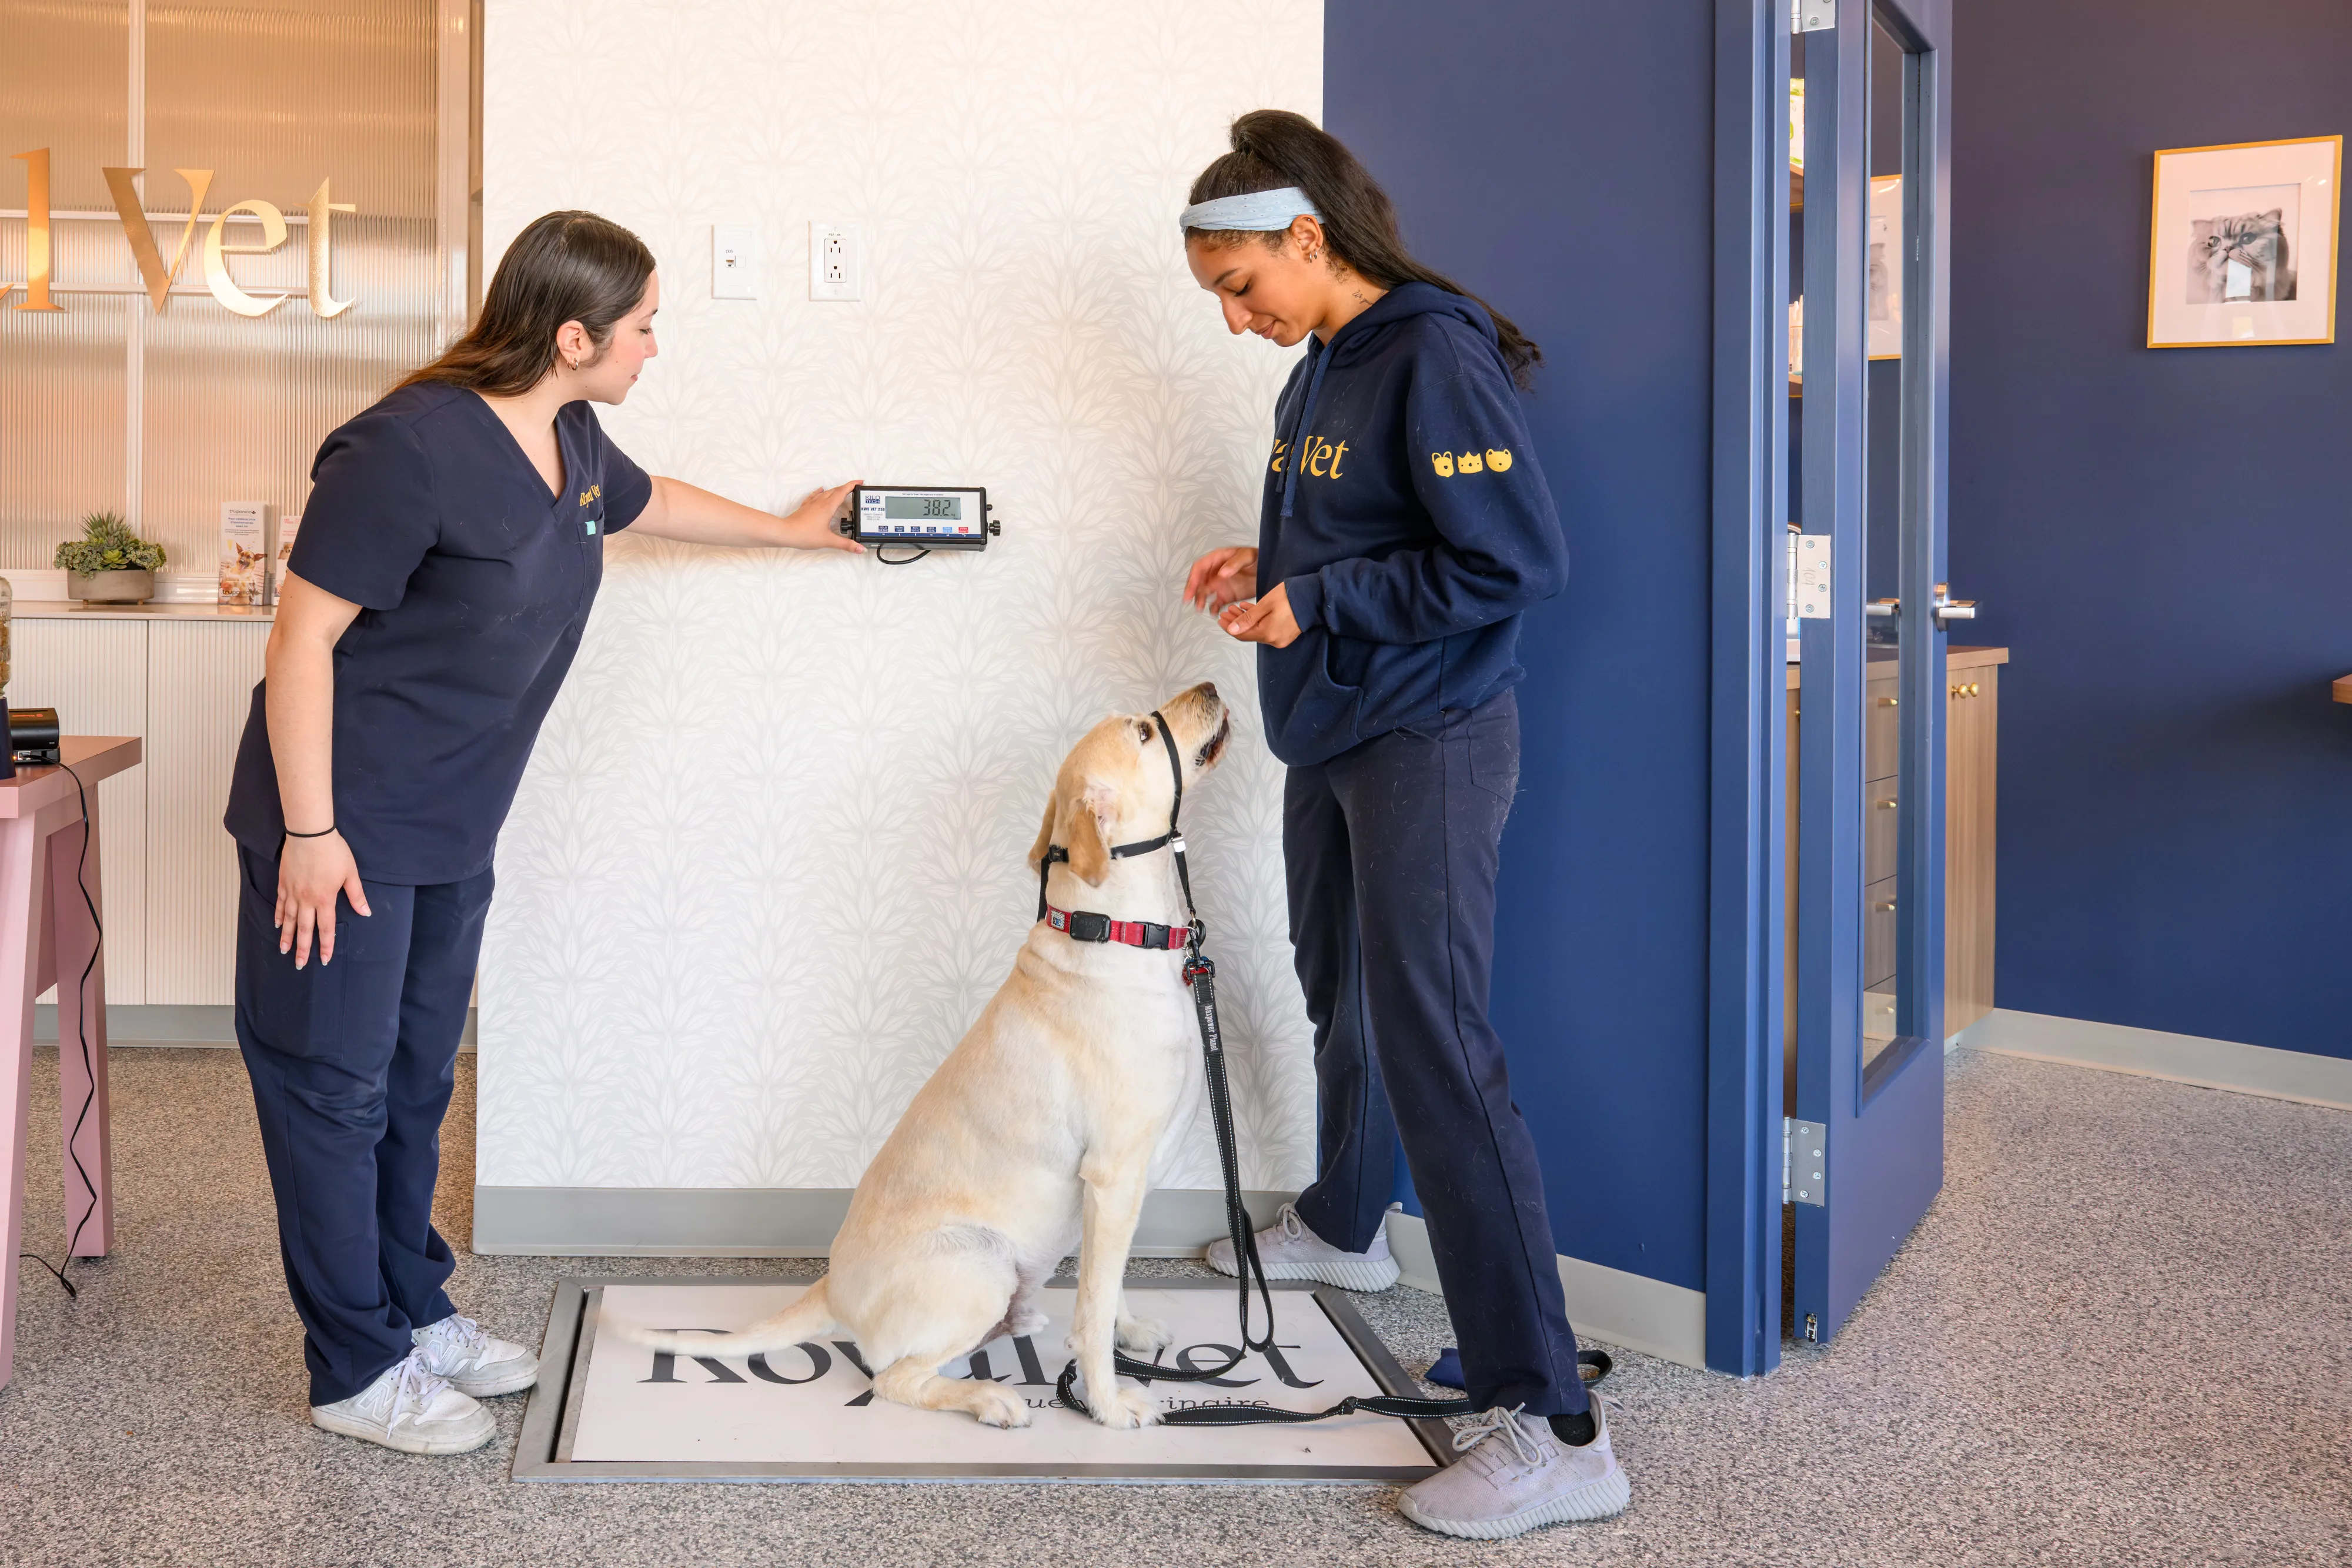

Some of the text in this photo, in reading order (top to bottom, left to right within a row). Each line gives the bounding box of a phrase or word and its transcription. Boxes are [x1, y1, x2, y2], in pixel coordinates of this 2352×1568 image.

[0, 148, 356, 317] l Vet
[1301, 436, 1349, 479] Vet
[580, 483, 601, 508] Royal Vet
[923, 499, 951, 516] 38.2
[1205, 1005, 1219, 1052] Maxpower Planet
